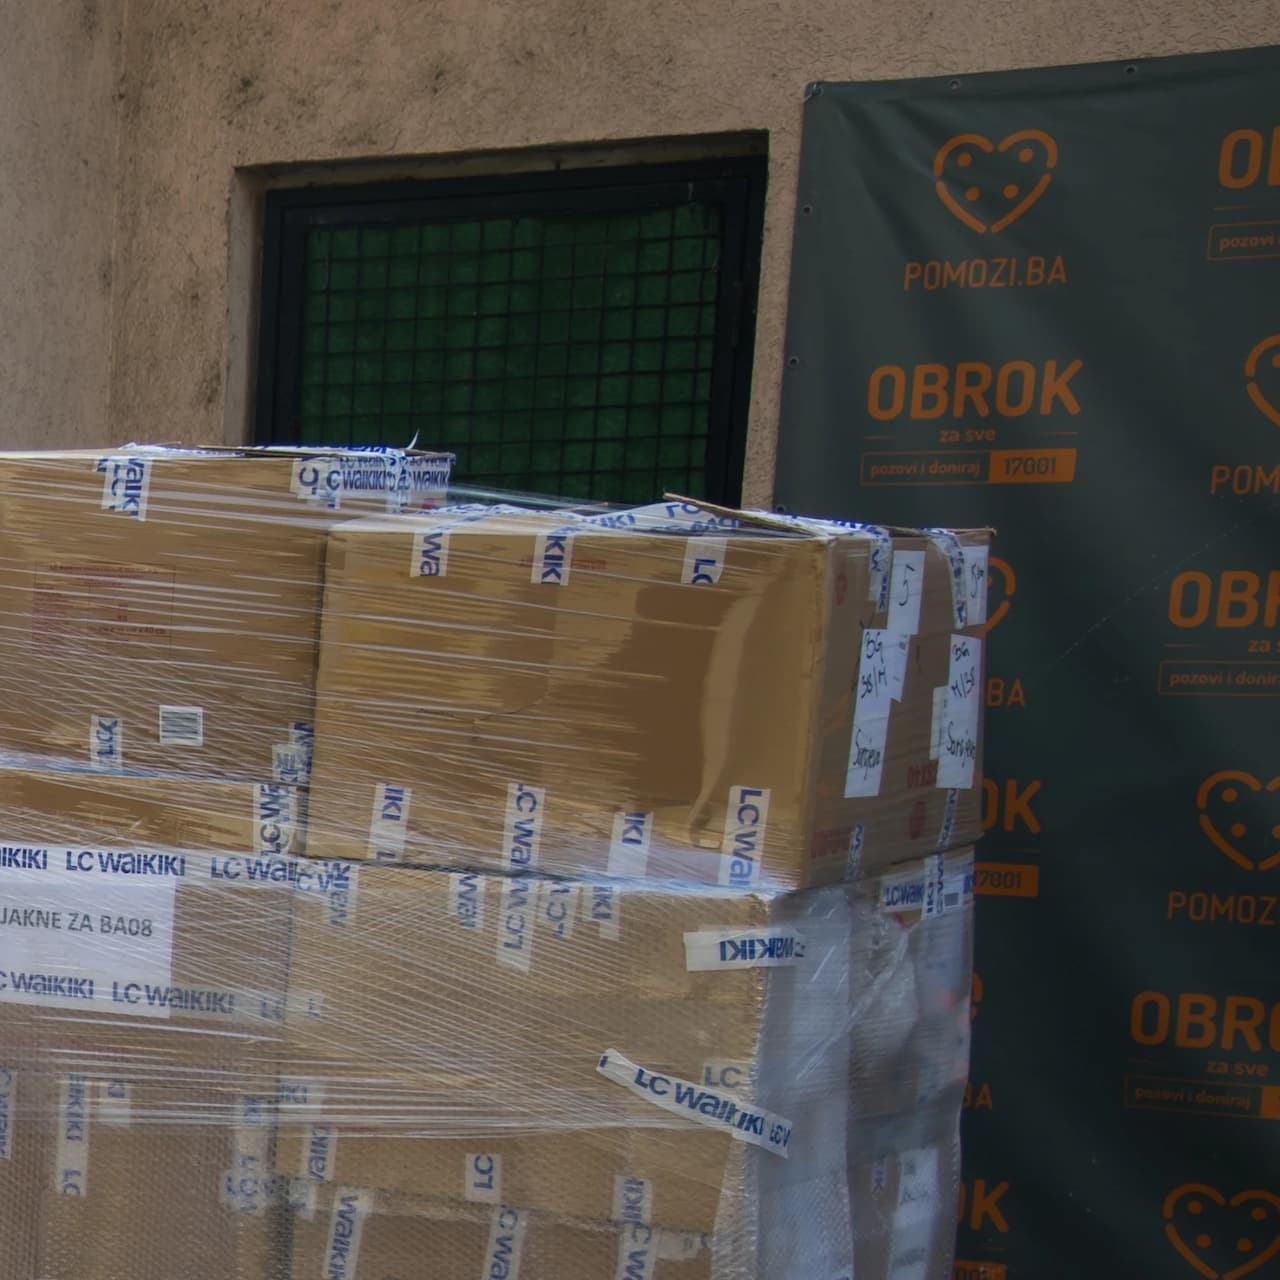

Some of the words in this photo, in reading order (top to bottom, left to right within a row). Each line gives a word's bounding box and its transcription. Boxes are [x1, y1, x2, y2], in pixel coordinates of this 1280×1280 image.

[903, 256, 1068, 291] POMOZI.BA
[867, 359, 1083, 420] OBROK
[939, 430, 960, 443] za
[964, 429, 997, 442] sve
[739, 788, 762, 823] LC
[65, 851, 93, 872] LC
[211, 857, 241, 879] LC
[0, 906, 62, 929] JAKNE
[67, 912, 93, 932] ZA
[100, 916, 153, 937] BA08
[112, 981, 142, 1005] LC
[1130, 991, 1280, 1053] OBR
[633, 1068, 674, 1096] LC
[473, 1155, 494, 1190] LC
